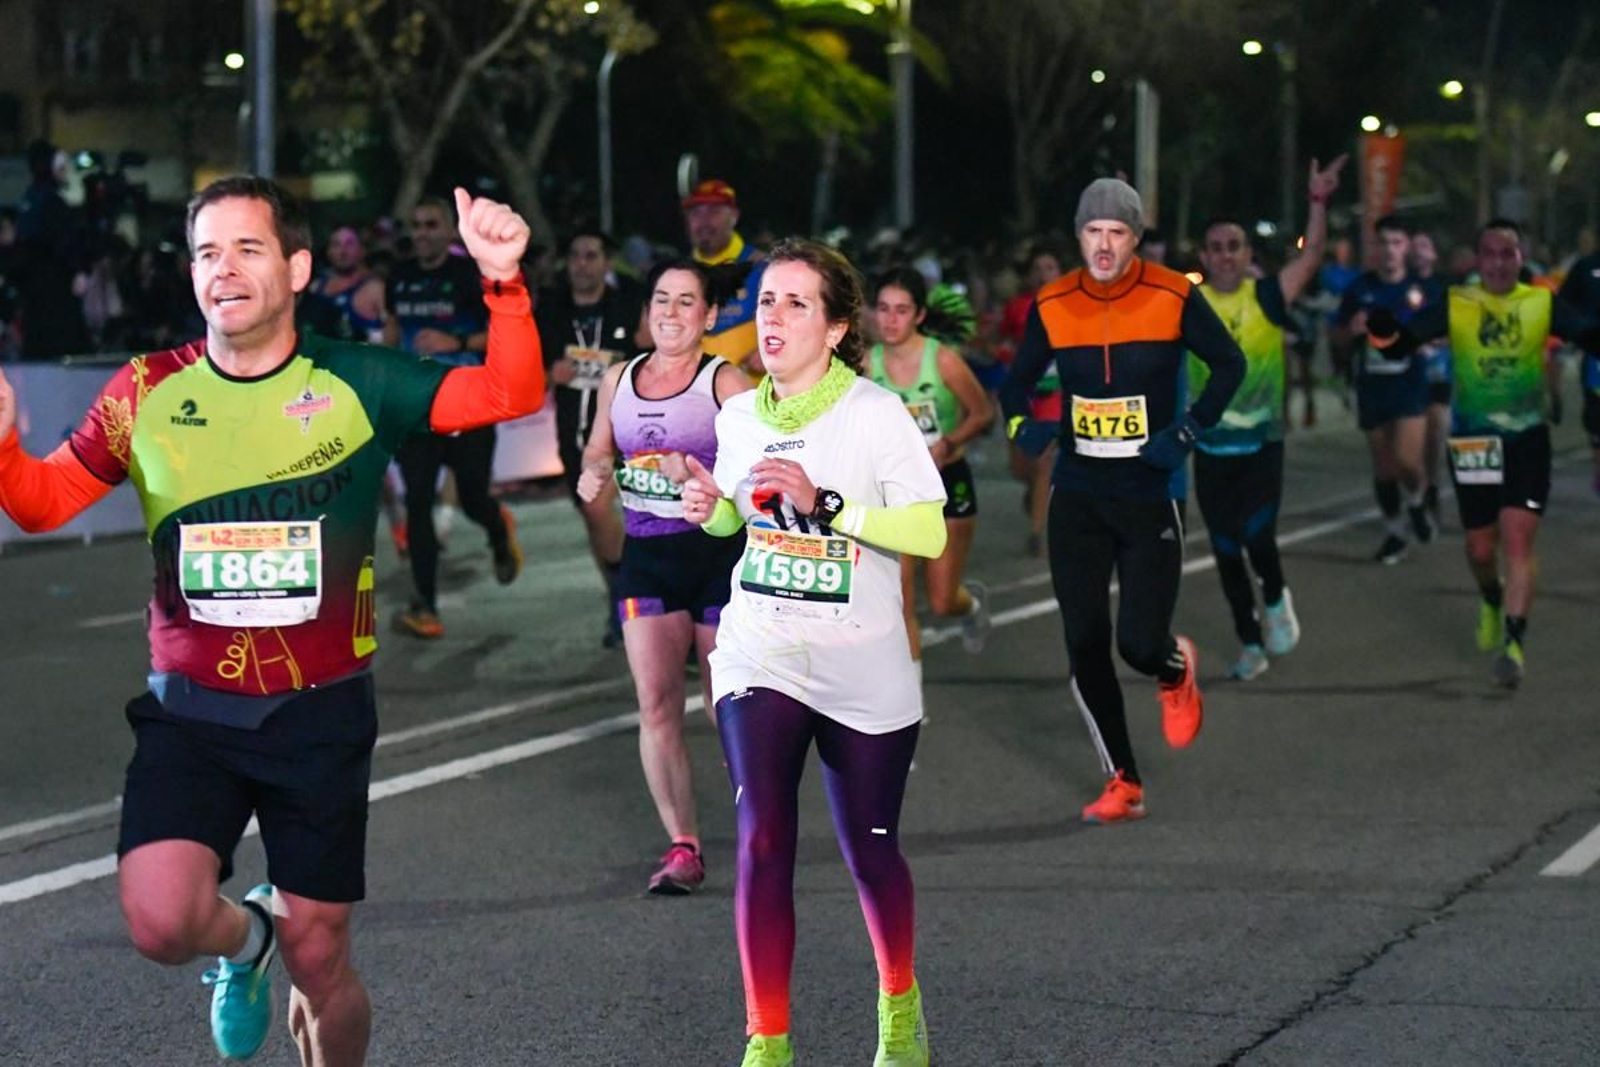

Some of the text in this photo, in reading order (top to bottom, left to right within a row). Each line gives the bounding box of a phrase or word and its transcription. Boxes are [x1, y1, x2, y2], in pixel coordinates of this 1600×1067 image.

[1078, 415, 1139, 435] 4176
[266, 436, 344, 480] VALDEPEÑAS
[191, 551, 310, 588] 1864
[749, 550, 843, 592] 1599
